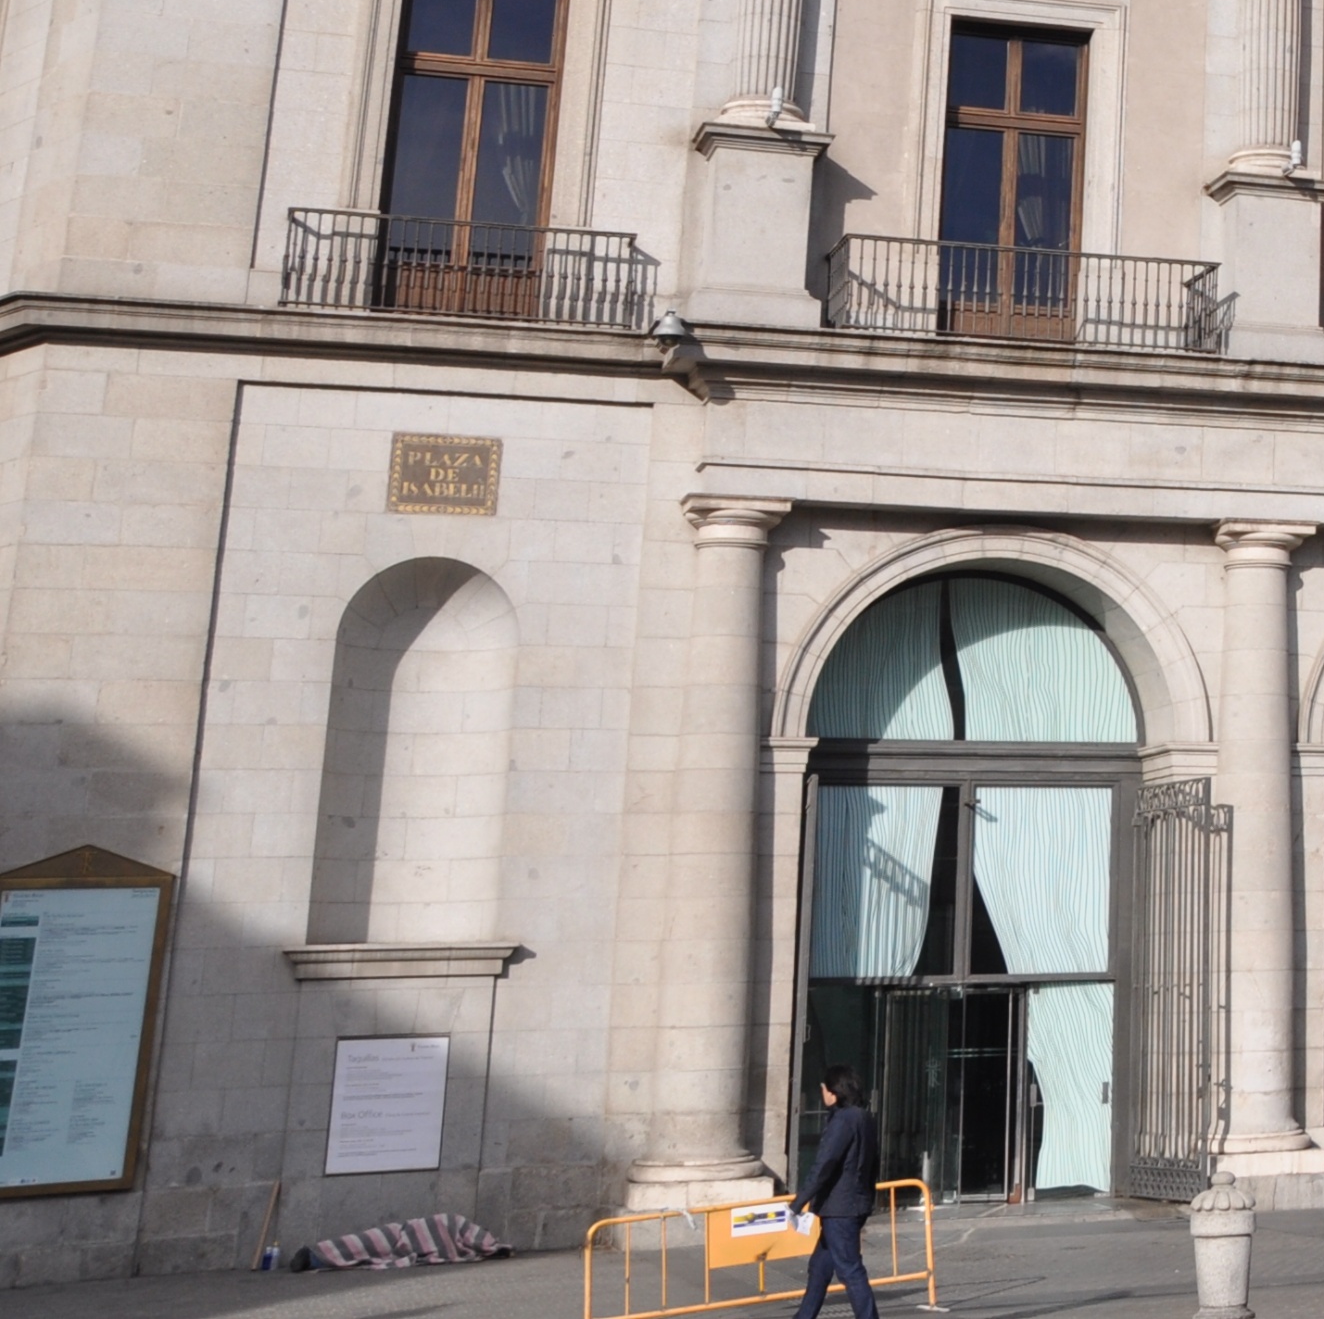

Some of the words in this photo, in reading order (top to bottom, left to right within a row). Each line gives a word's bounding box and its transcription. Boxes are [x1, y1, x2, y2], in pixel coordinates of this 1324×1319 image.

[408, 451, 483, 468] PLAZA
[430, 467, 459, 481] DE
[402, 481, 471, 498] ISABEL
